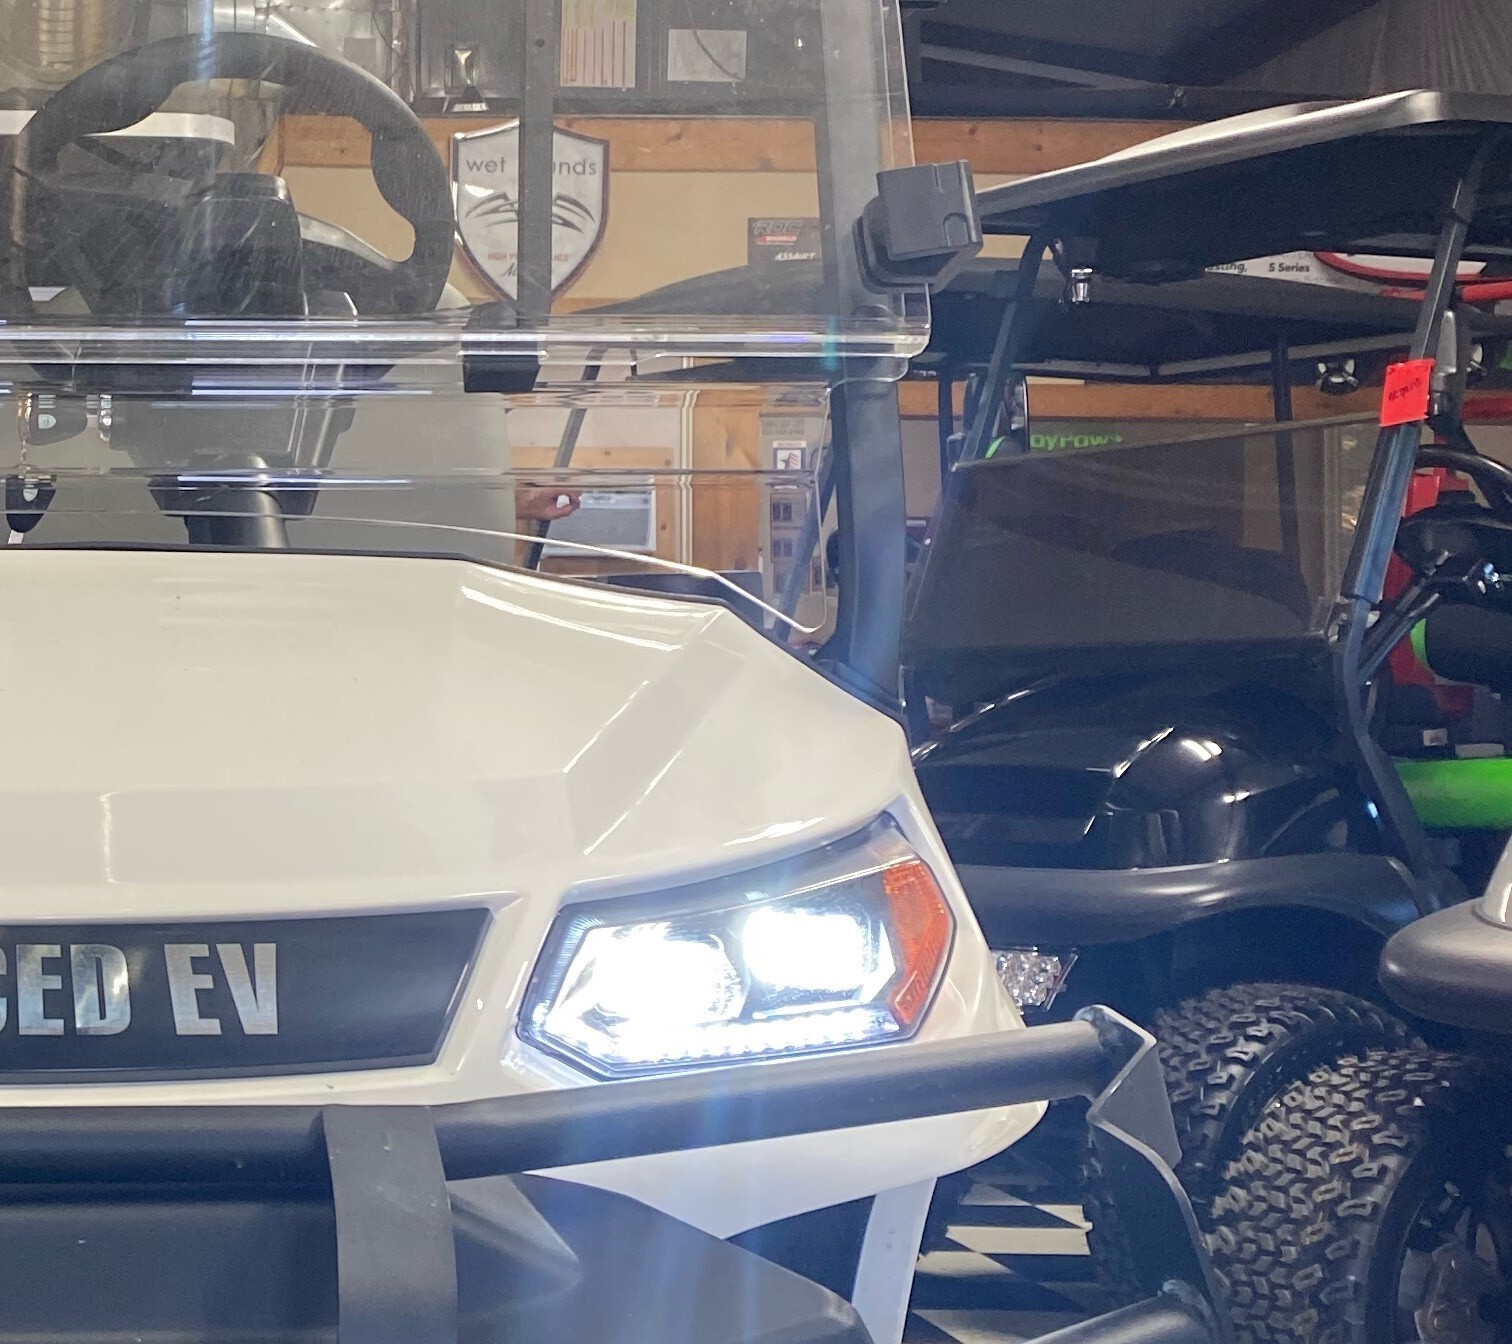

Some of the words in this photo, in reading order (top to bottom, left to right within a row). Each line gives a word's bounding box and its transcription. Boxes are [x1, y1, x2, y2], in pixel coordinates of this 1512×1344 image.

[466, 157, 505, 173] wet
[552, 157, 597, 176] nds
[1269, 262, 1275, 272] S
[1278, 262, 1310, 272] Series
[163, 942, 279, 1036] EV
